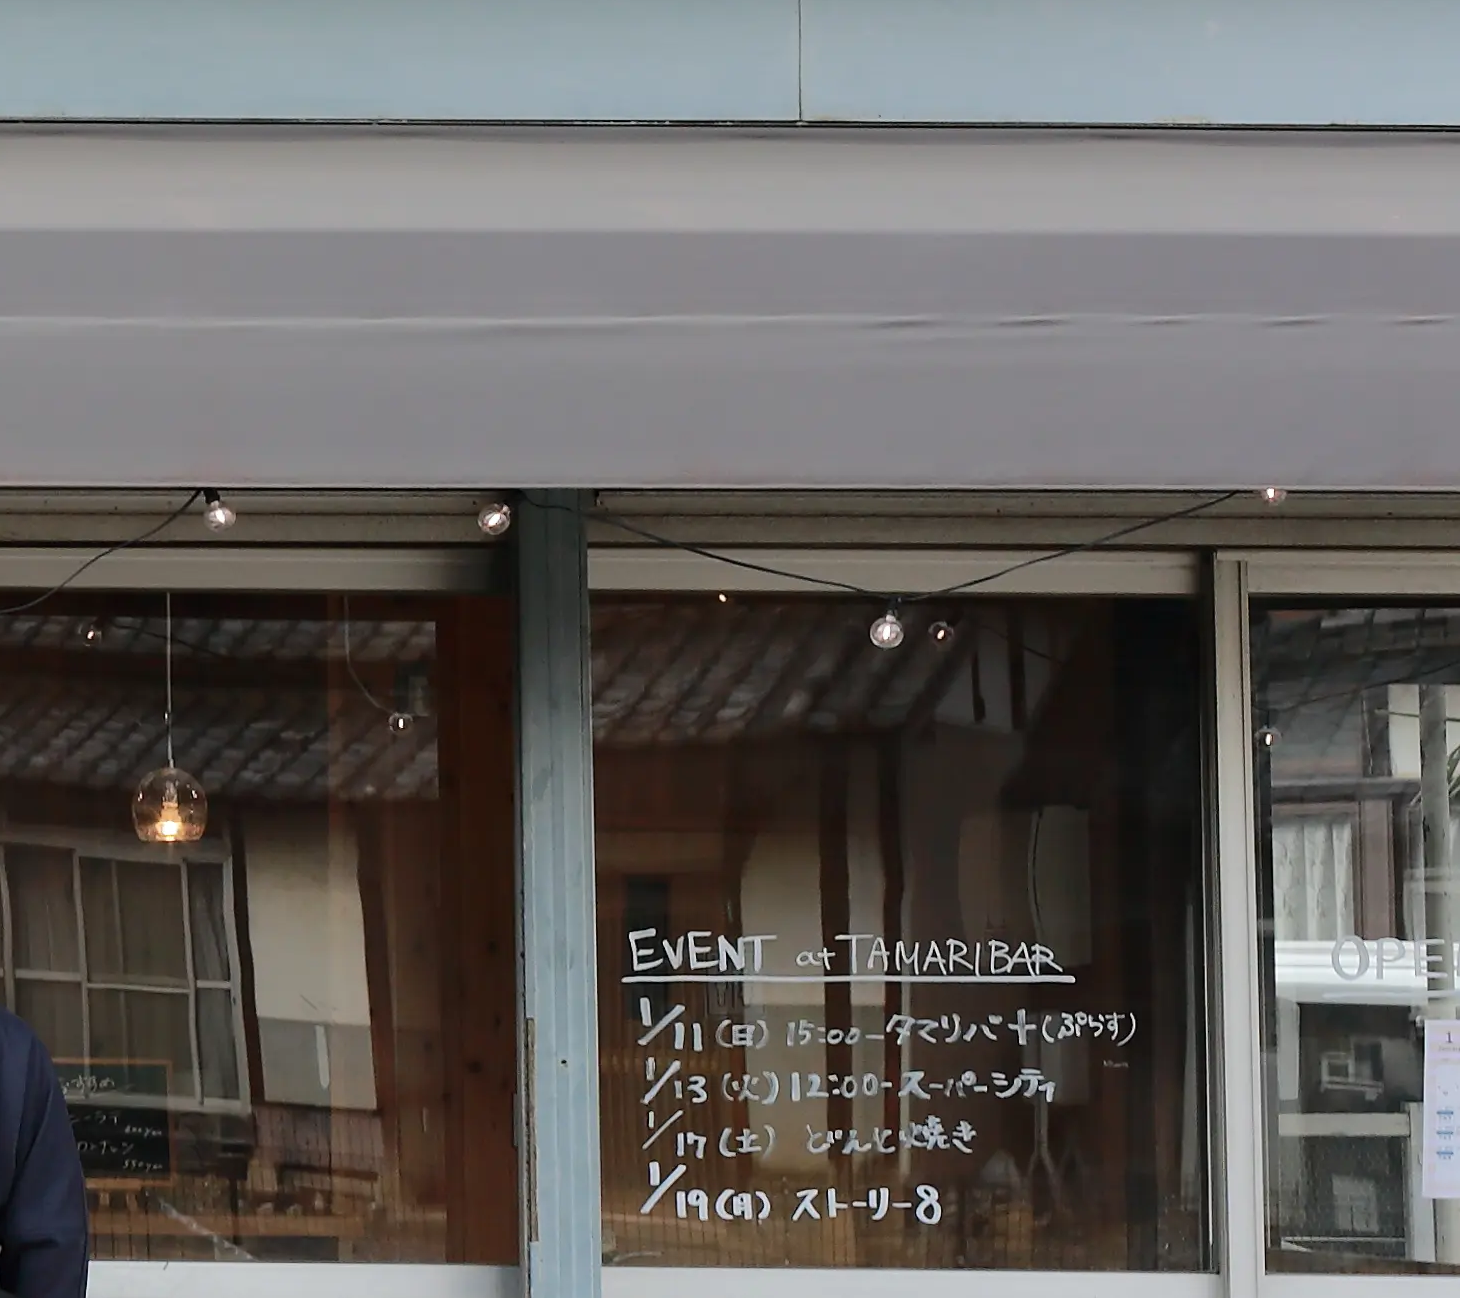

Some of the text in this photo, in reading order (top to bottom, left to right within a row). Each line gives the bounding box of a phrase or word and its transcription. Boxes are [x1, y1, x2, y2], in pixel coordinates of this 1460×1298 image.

[628, 928, 1064, 977] EVENT at TAMARIBAR
[1331, 934, 1460, 981] OPE
